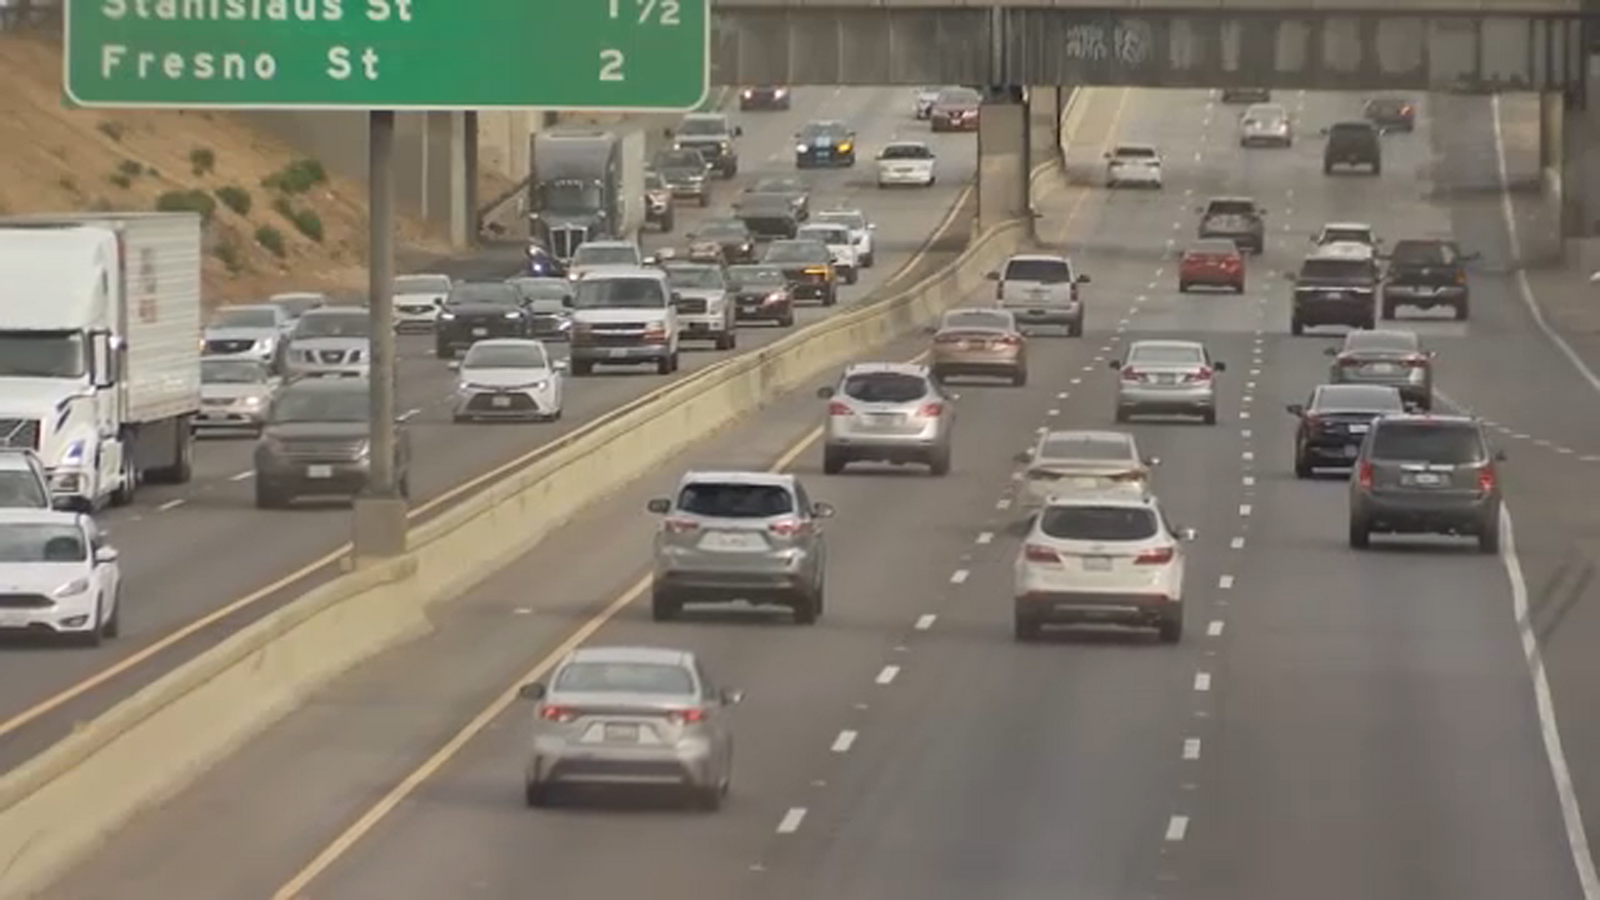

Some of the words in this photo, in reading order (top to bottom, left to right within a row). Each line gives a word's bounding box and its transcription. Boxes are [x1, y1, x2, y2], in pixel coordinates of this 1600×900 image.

[367, 0, 411, 21] St
[102, 45, 275, 79] Fresno
[328, 46, 378, 80] St
[599, 49, 624, 81] 2
